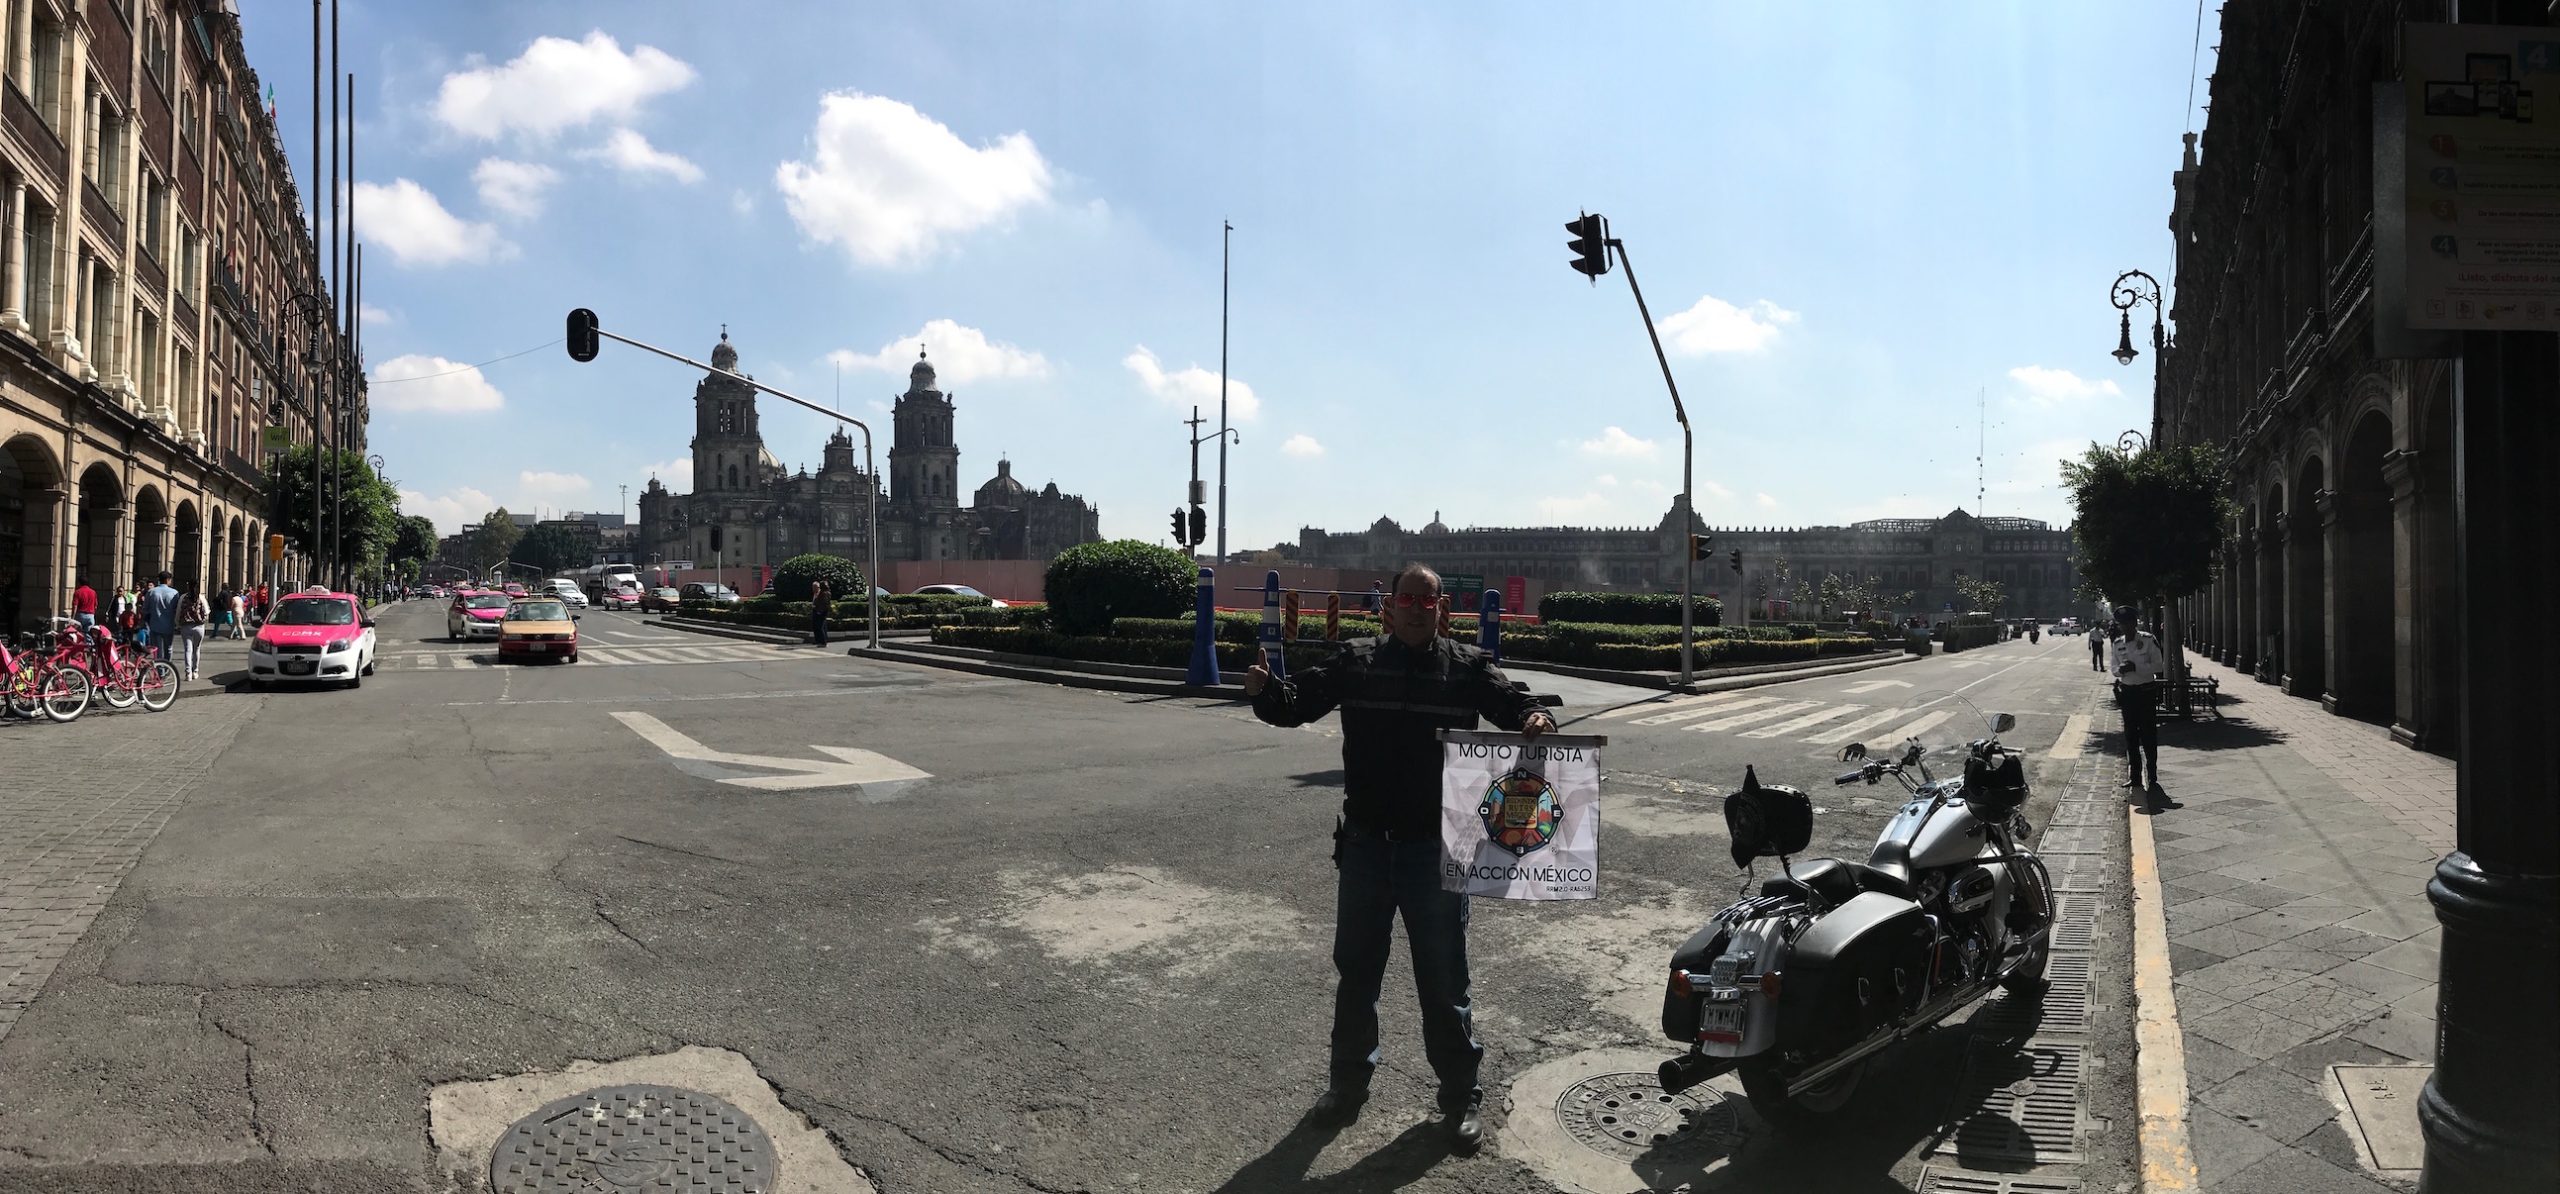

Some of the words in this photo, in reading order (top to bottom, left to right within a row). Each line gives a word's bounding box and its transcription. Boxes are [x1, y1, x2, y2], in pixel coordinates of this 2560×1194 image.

[1459, 743, 1512, 760] MOTO
[1517, 745, 1584, 763] TURISTA
[1446, 863, 1465, 878] EN
[1469, 863, 1530, 881] ACCIÓN
[1534, 865, 1592, 882] MÉXICO
